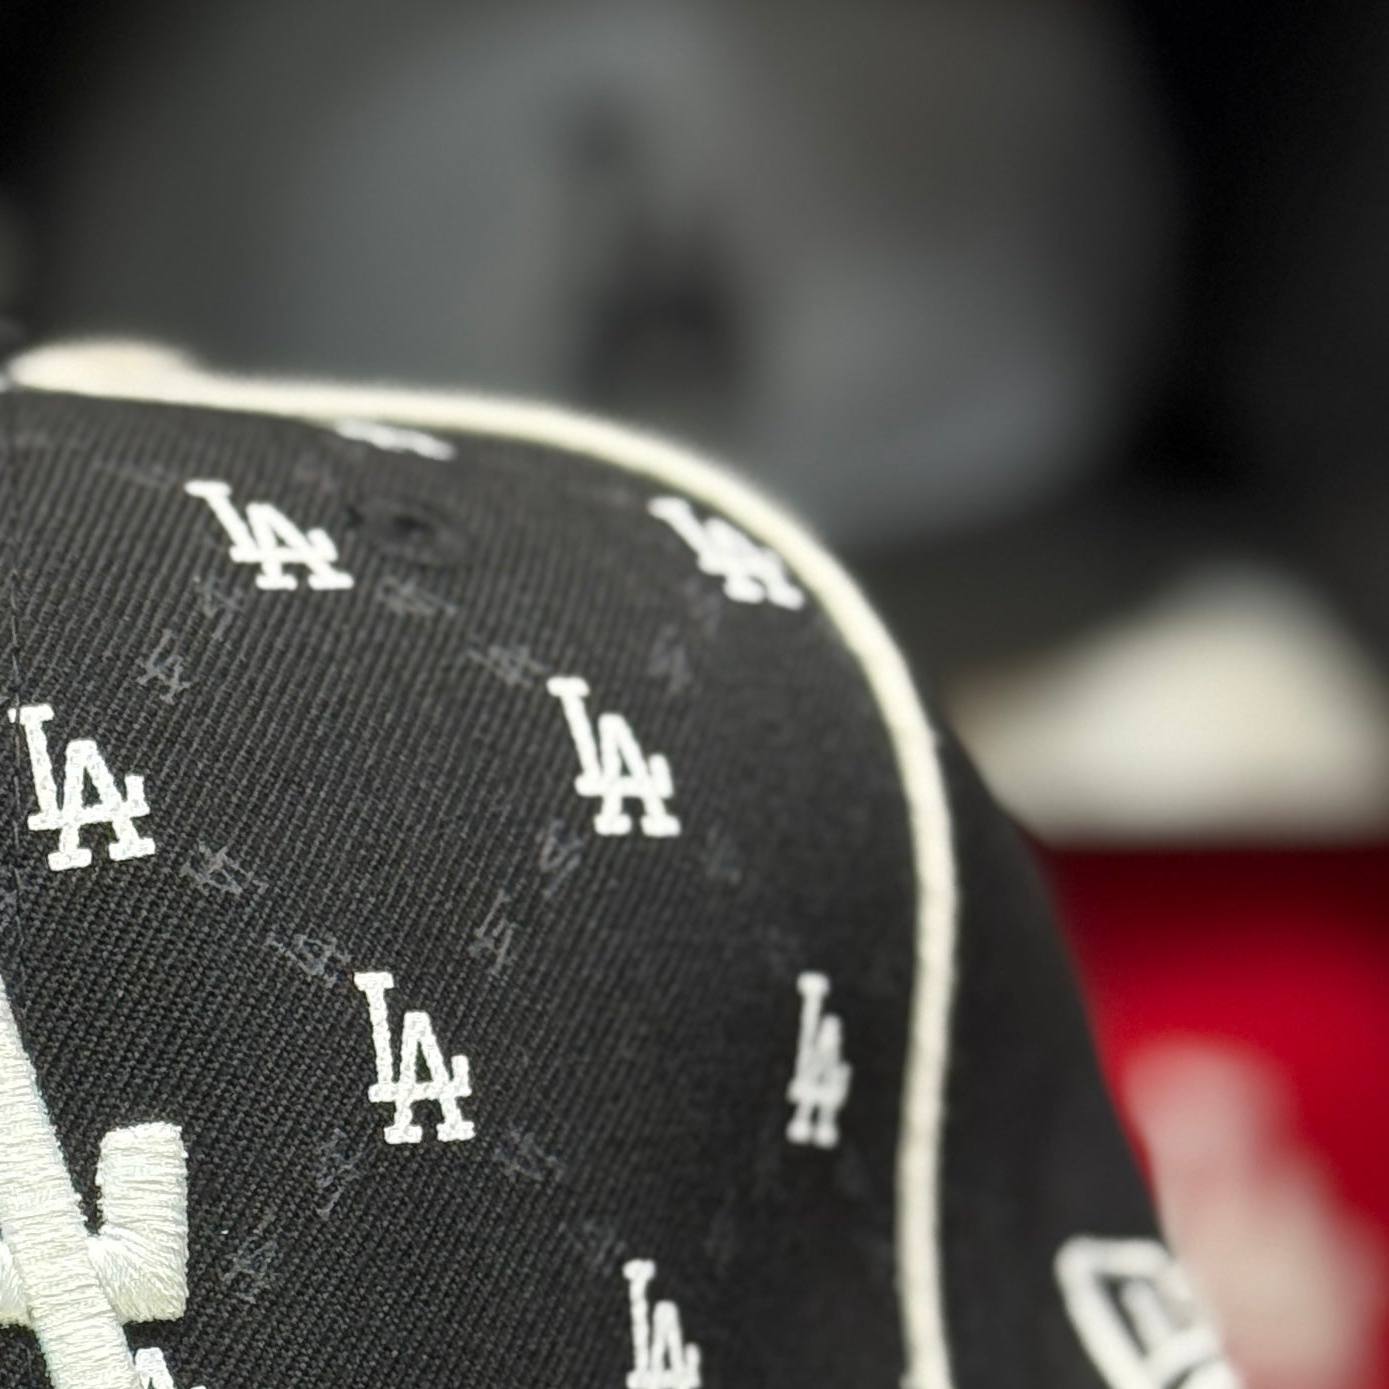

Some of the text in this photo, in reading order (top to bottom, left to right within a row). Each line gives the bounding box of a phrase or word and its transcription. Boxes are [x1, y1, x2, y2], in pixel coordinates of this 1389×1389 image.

[184, 479, 354, 591] LA
[8, 702, 158, 872] LA
[546, 675, 681, 837] LA
[354, 971, 476, 1144] LA
[787, 972, 852, 1149] LA
